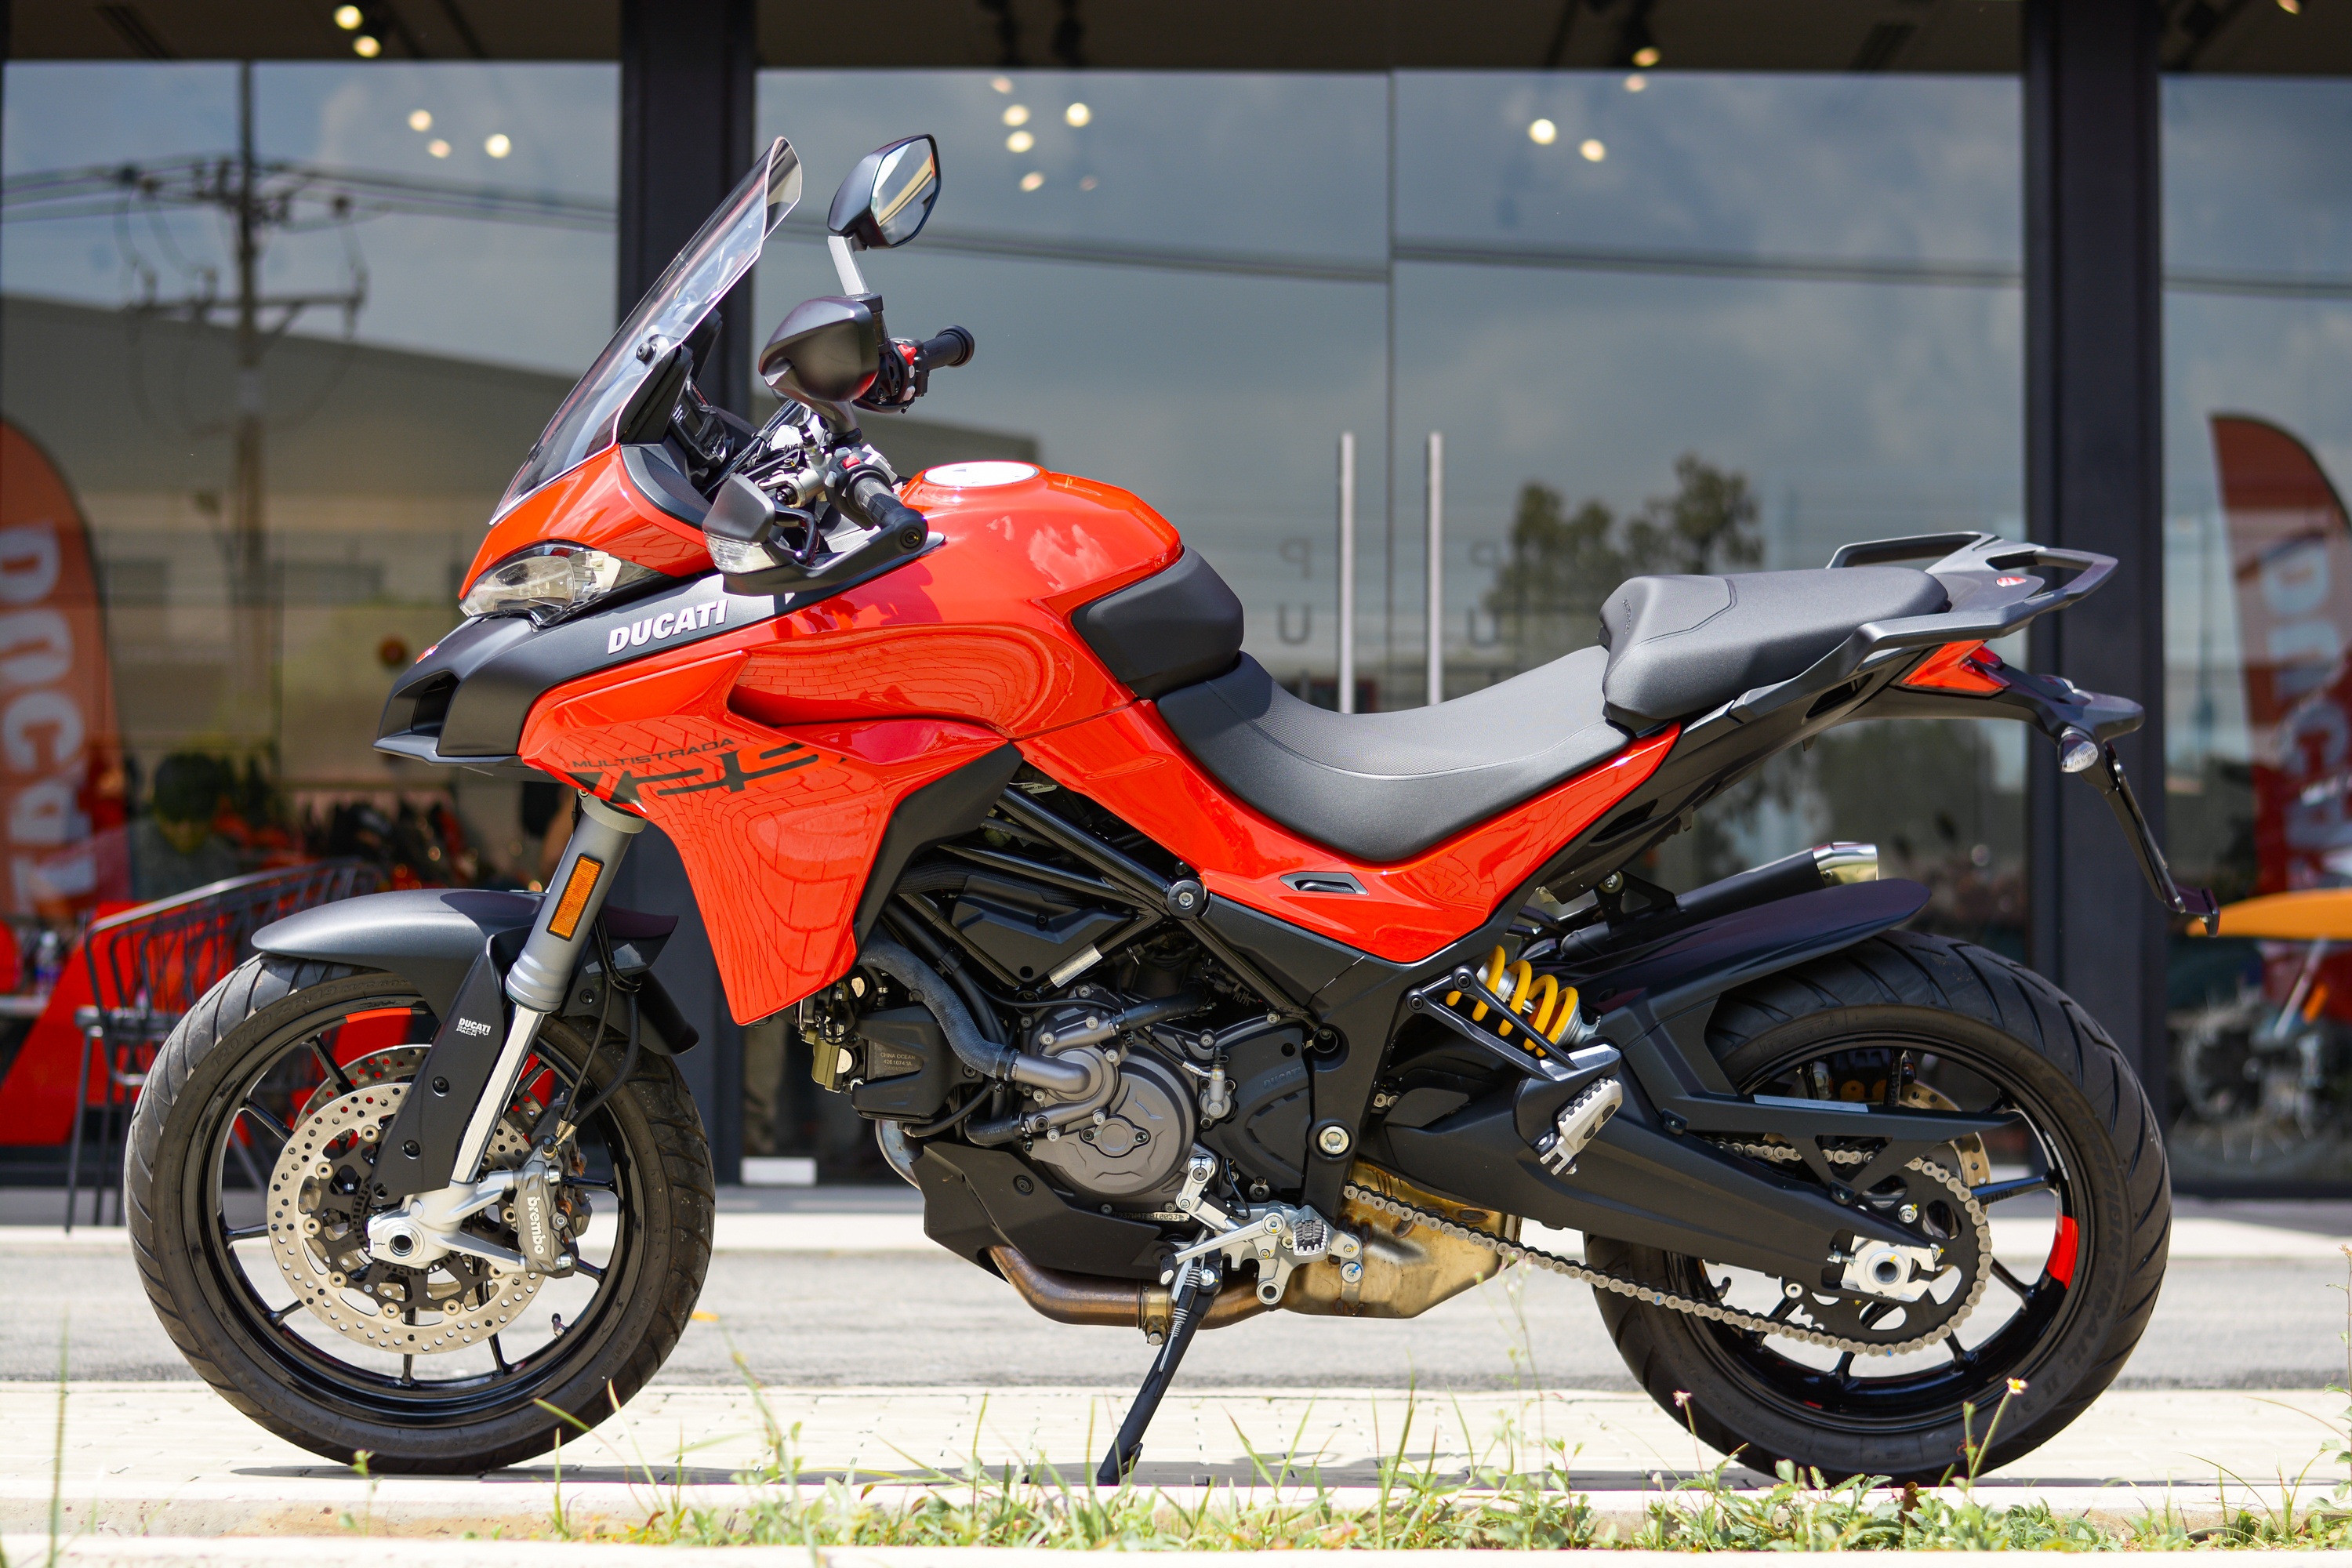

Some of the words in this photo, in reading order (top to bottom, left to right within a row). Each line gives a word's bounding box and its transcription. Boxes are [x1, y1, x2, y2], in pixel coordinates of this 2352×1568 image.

[608, 599, 729, 655] DUCATI
[572, 738, 735, 768] MULTISTRADA
[212, 1014, 272, 1068] 120/70
[314, 985, 337, 1001] 19
[456, 1028, 477, 1037] PACK
[457, 1025, 489, 1036] SAFETY
[458, 1018, 492, 1033] DUCATI
[1263, 1066, 1301, 1089] DUCATI
[527, 1196, 546, 1254] brembo
